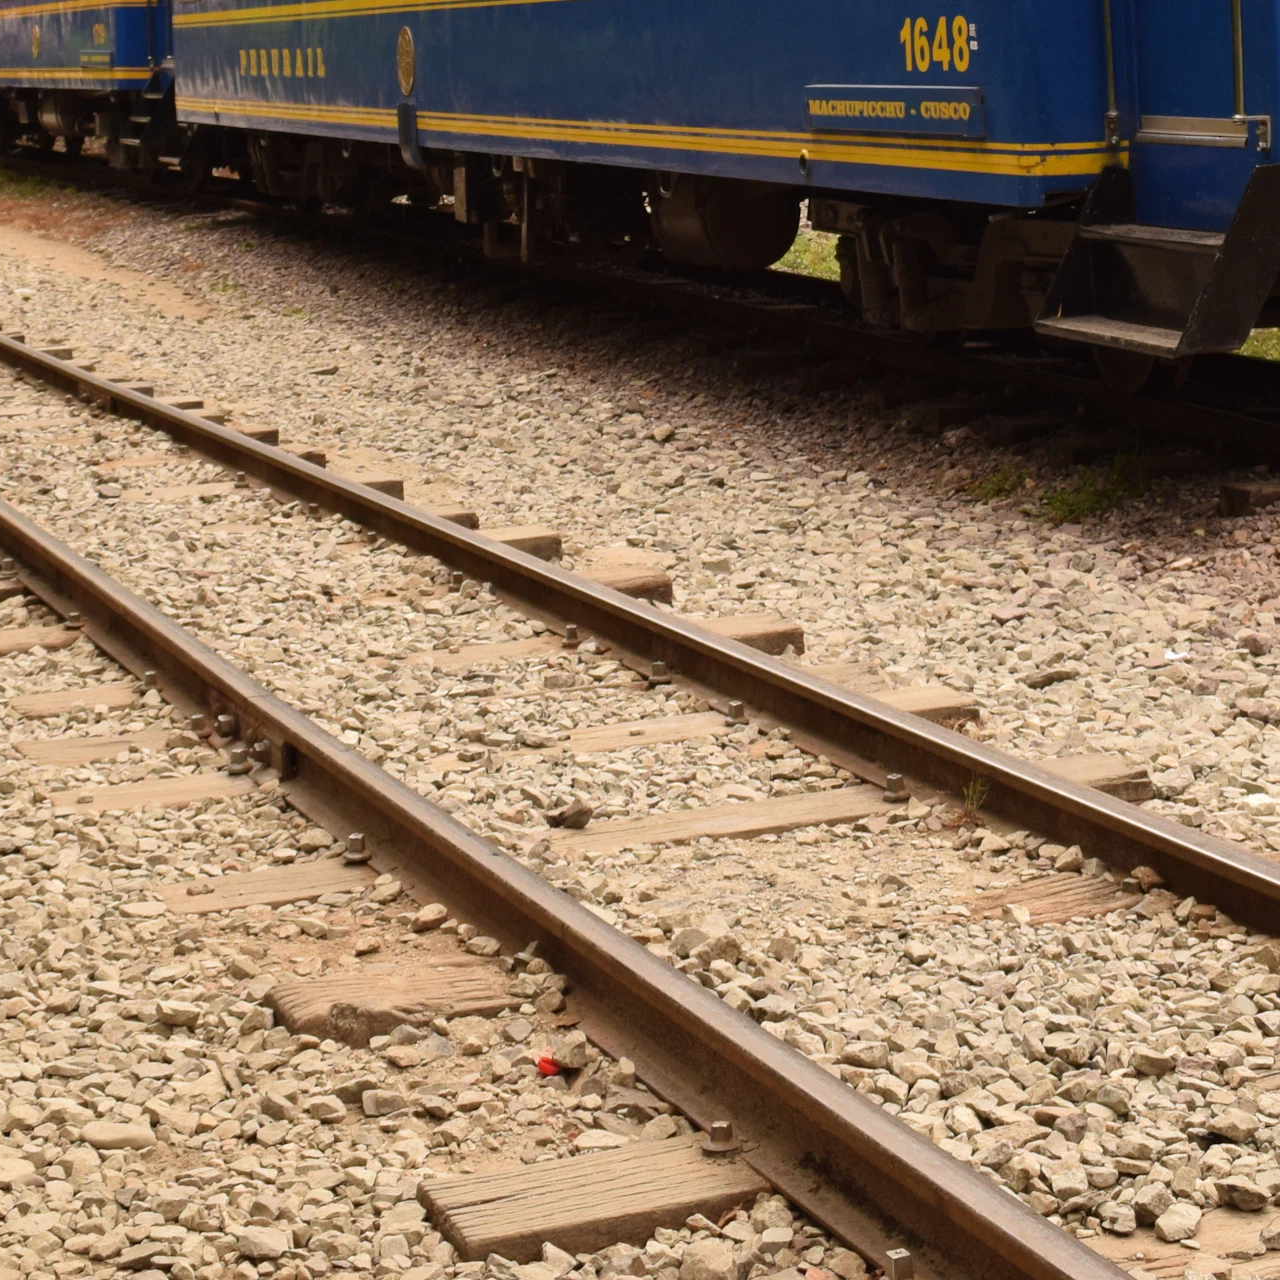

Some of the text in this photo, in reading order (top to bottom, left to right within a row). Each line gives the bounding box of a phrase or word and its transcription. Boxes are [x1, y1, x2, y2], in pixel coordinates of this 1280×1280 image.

[899, 14, 970, 73] 1648
[239, 47, 326, 79] PERURAIL
[808, 99, 907, 119] MACHUPICCHU
[919, 100, 972, 121] CUSCO
